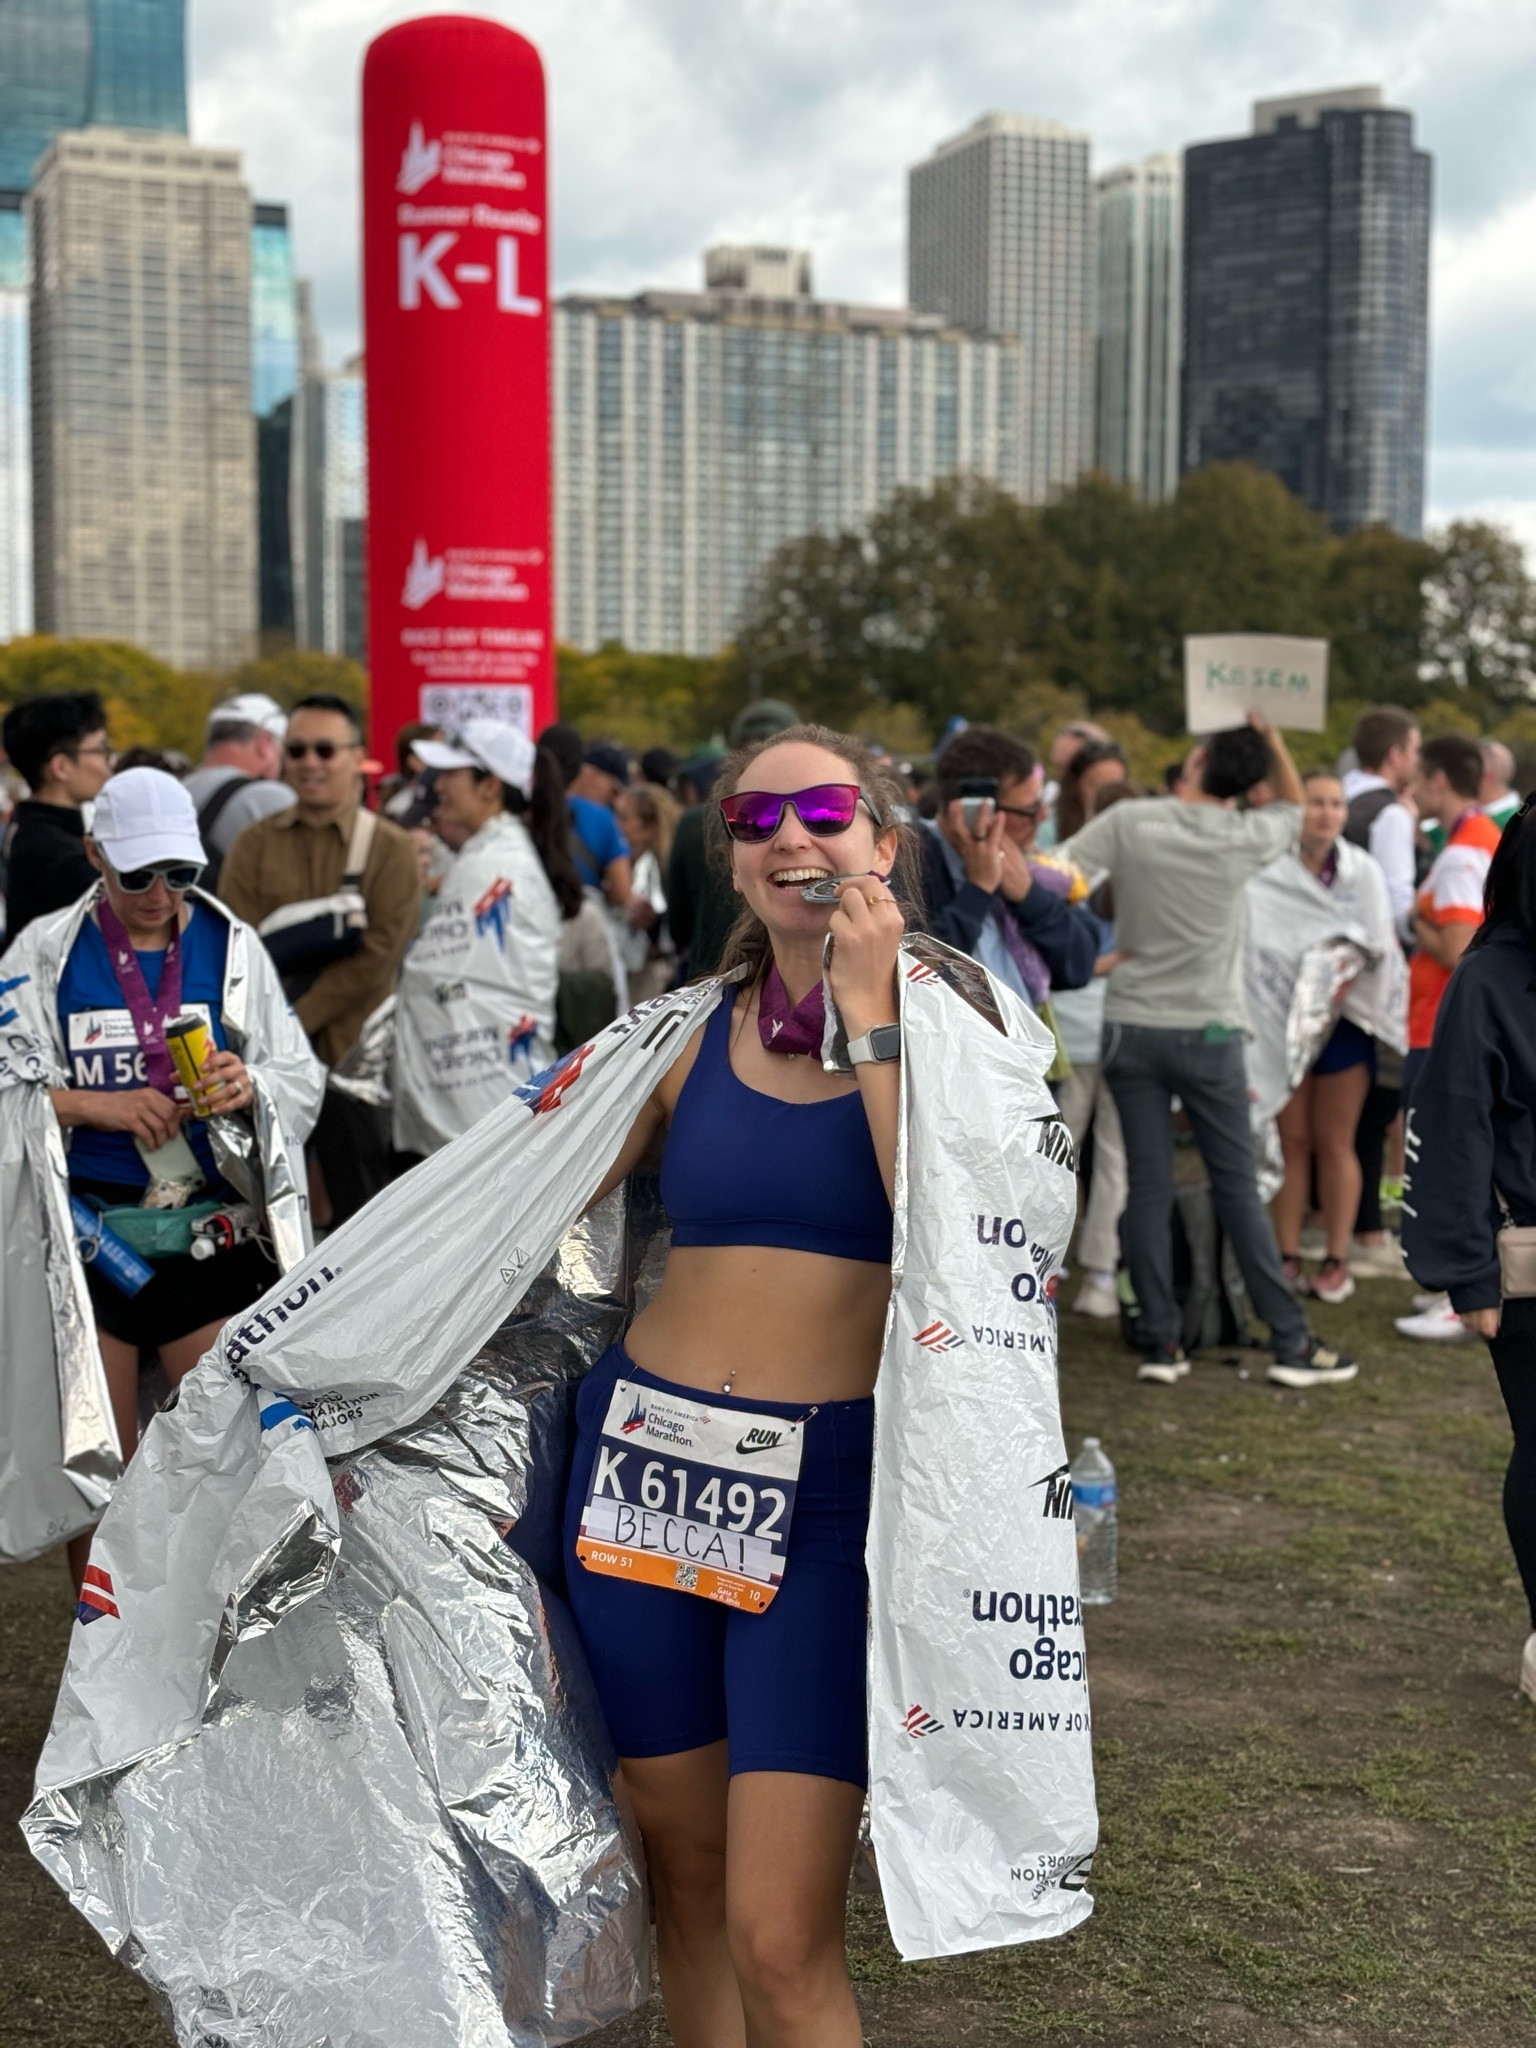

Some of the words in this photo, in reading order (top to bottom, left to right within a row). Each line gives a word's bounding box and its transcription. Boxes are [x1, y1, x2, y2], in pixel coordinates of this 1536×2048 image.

[398, 231, 542, 318] K-L
[74, 1053, 105, 1087] M
[648, 1412, 685, 1434] Chicago
[745, 1428, 783, 1446] RUN
[593, 1446, 628, 1500] K
[640, 1461, 786, 1541] 61492
[614, 1504, 745, 1572] BECCA!
[591, 1550, 618, 1566] ROW
[620, 1556, 633, 1568] 51
[717, 1586, 732, 1597] Gate
[749, 1590, 760, 1601] 10
[953, 1709, 1060, 1731] AMERICA
[1065, 1712, 1082, 1731] OF
